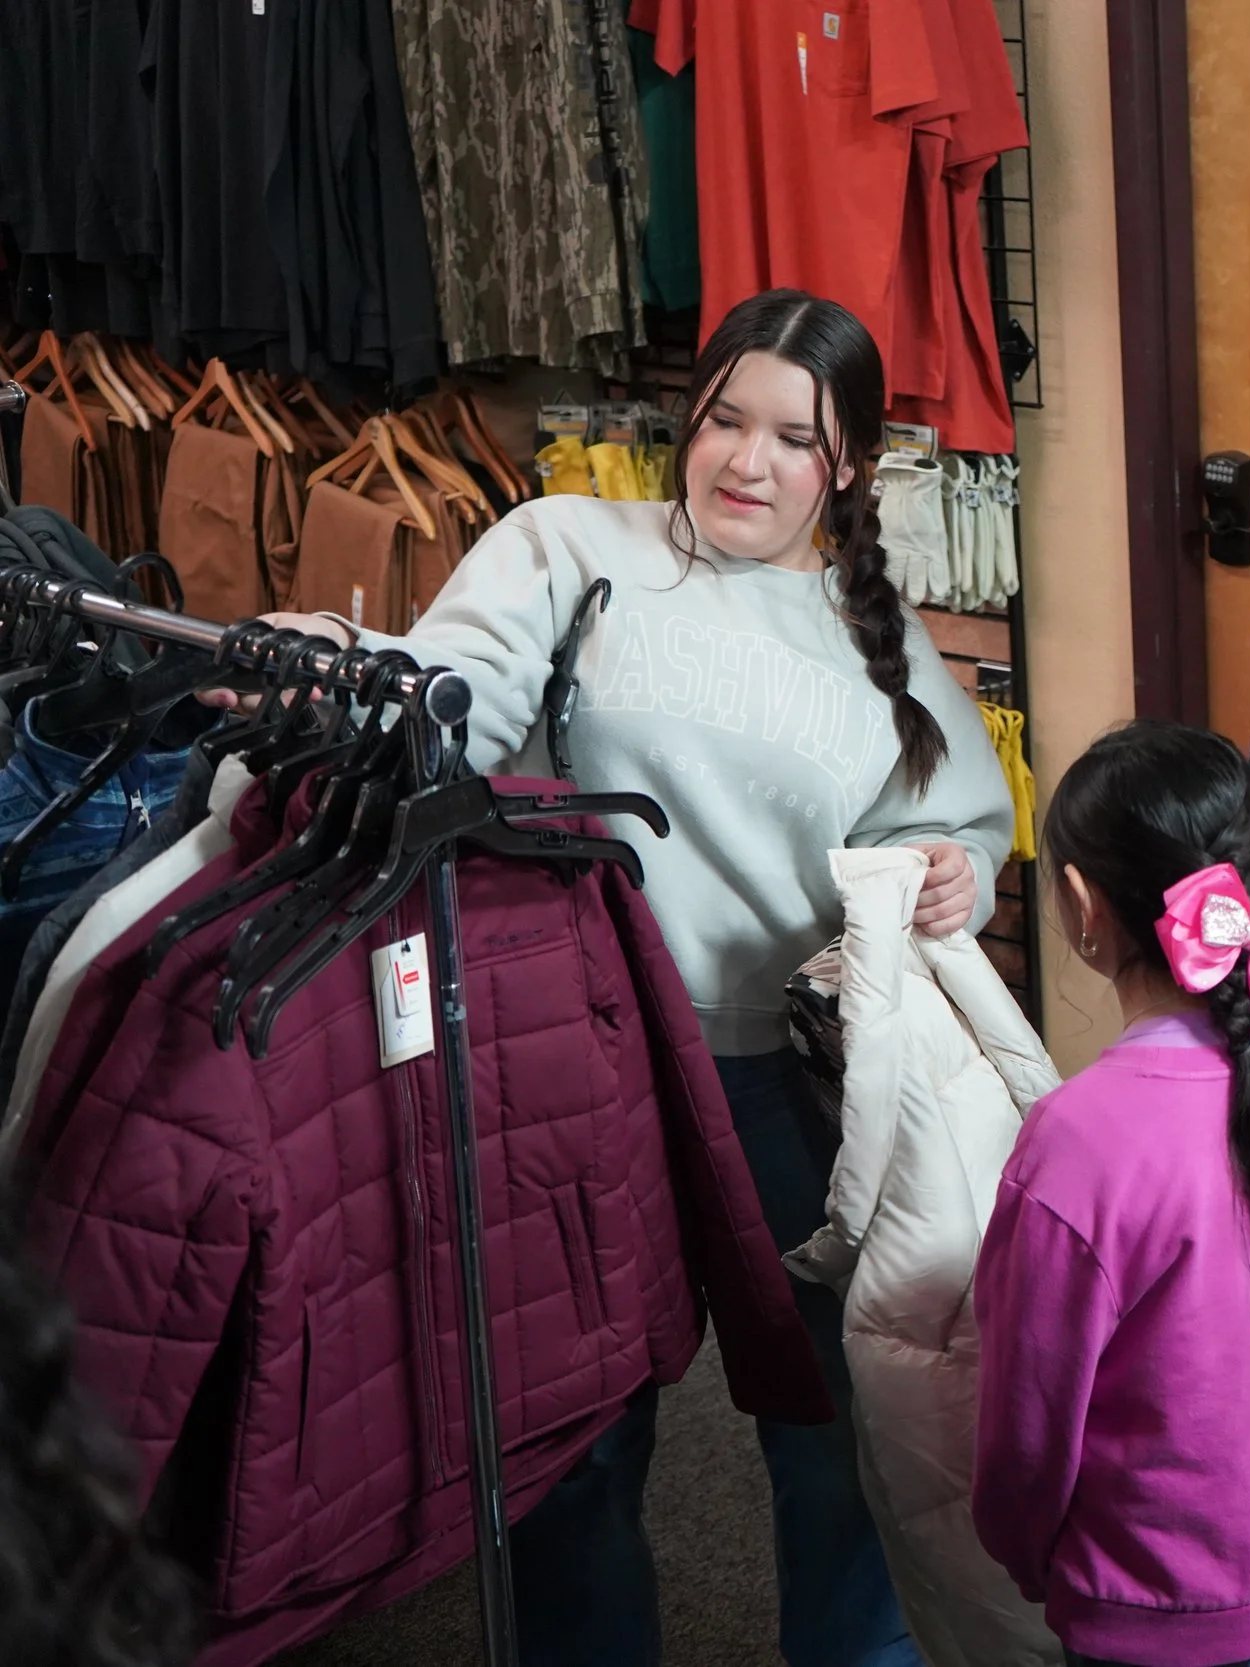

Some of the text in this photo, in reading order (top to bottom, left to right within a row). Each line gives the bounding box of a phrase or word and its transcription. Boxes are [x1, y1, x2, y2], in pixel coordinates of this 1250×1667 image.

[577, 592, 886, 825] ASHVILL
[648, 746, 819, 819] EST. 1806
